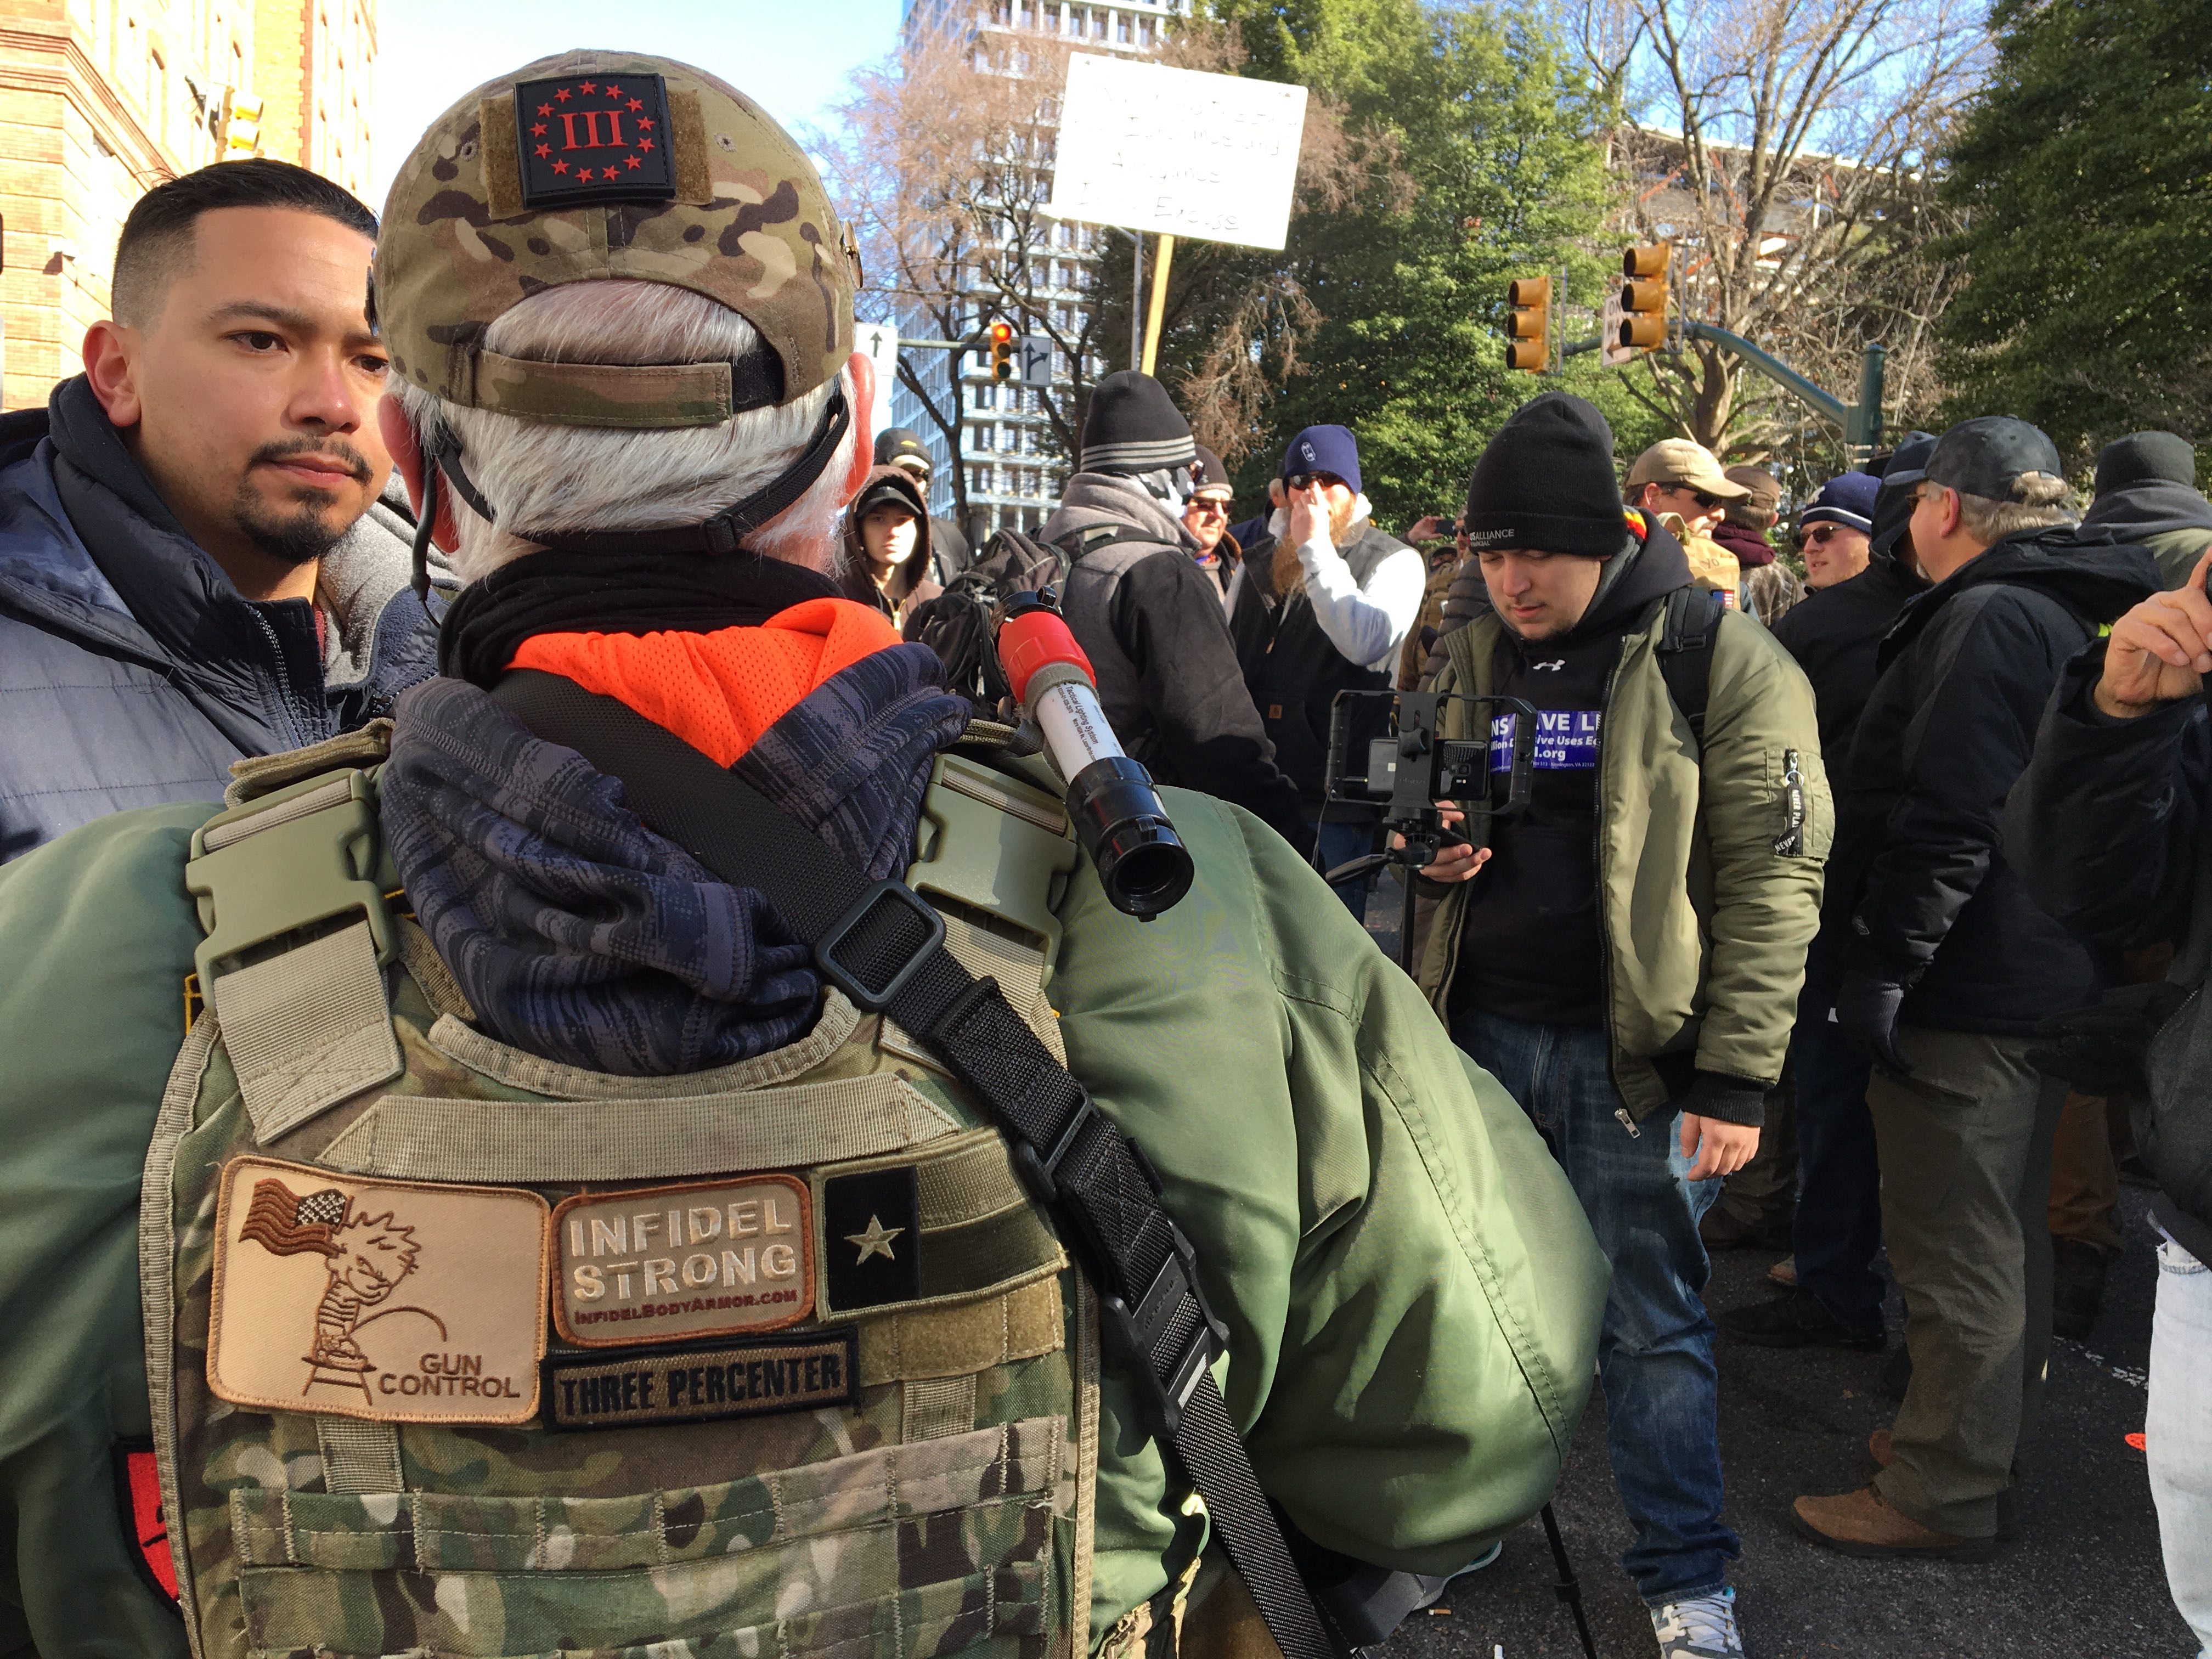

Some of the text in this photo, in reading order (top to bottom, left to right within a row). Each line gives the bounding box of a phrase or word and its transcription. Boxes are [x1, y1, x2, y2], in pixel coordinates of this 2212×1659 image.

[557, 110, 629, 150] III
[1609, 299, 1622, 316] ON
[1607, 317, 1621, 336] WA
[1066, 686, 1098, 744] Tactical Lighting System
[1557, 736, 1583, 745] Uses
[1792, 789, 1801, 810] NEVER
[569, 1199, 792, 1257] INFIDEL
[574, 1244, 796, 1302] STRONG
[419, 1352, 482, 1376] GUN
[377, 1373, 521, 1398] CONTROL
[560, 1353, 840, 1416] THREE PERCENTER
